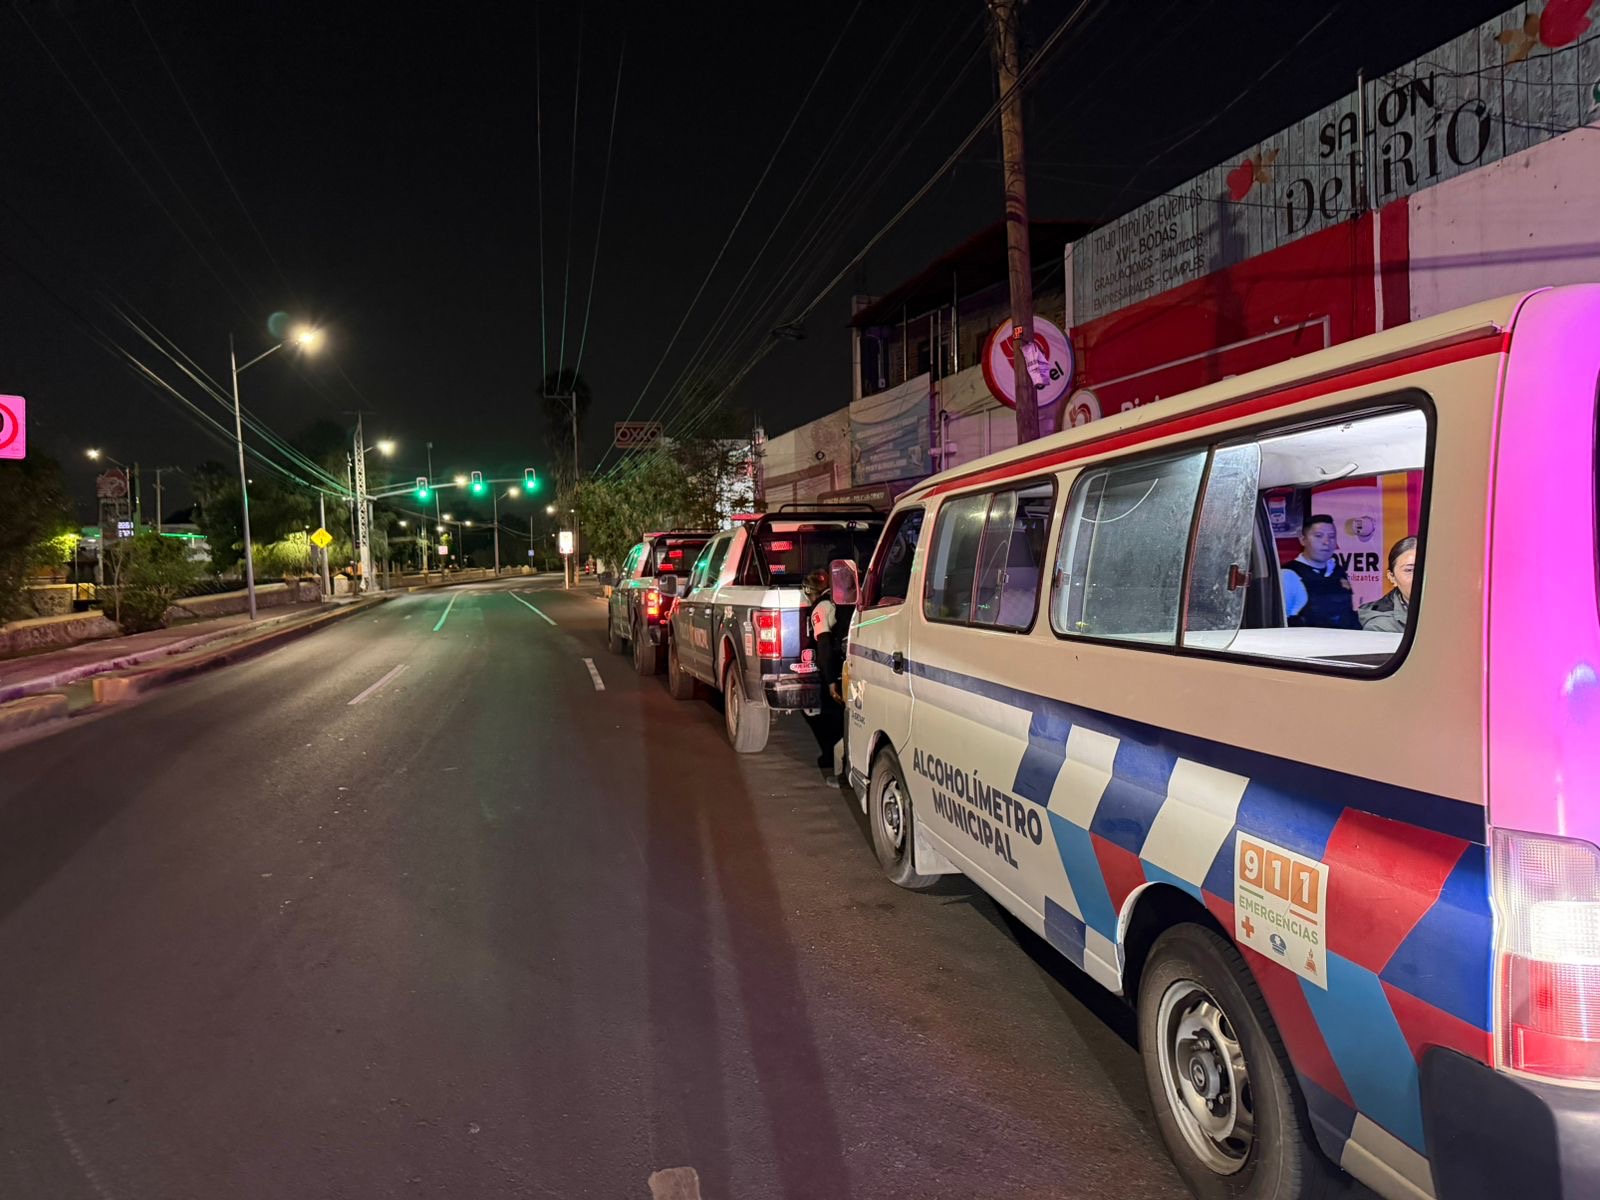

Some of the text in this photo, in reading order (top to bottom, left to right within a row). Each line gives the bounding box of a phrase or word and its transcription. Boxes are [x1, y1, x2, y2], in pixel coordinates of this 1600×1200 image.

[1094, 255, 1153, 292] GRADUACIONES
[1160, 233, 1203, 263] BAUTIZOS
[1140, 222, 1177, 255] BODAS
[1162, 254, 1204, 285] CUMPLES
[913, 747, 1042, 845] ALCOHOLÍMETRO
[932, 787, 1018, 870] MUNICIPAL
[1244, 849, 1310, 904] 911
[1239, 894, 1318, 946] EMERGENCIAS
